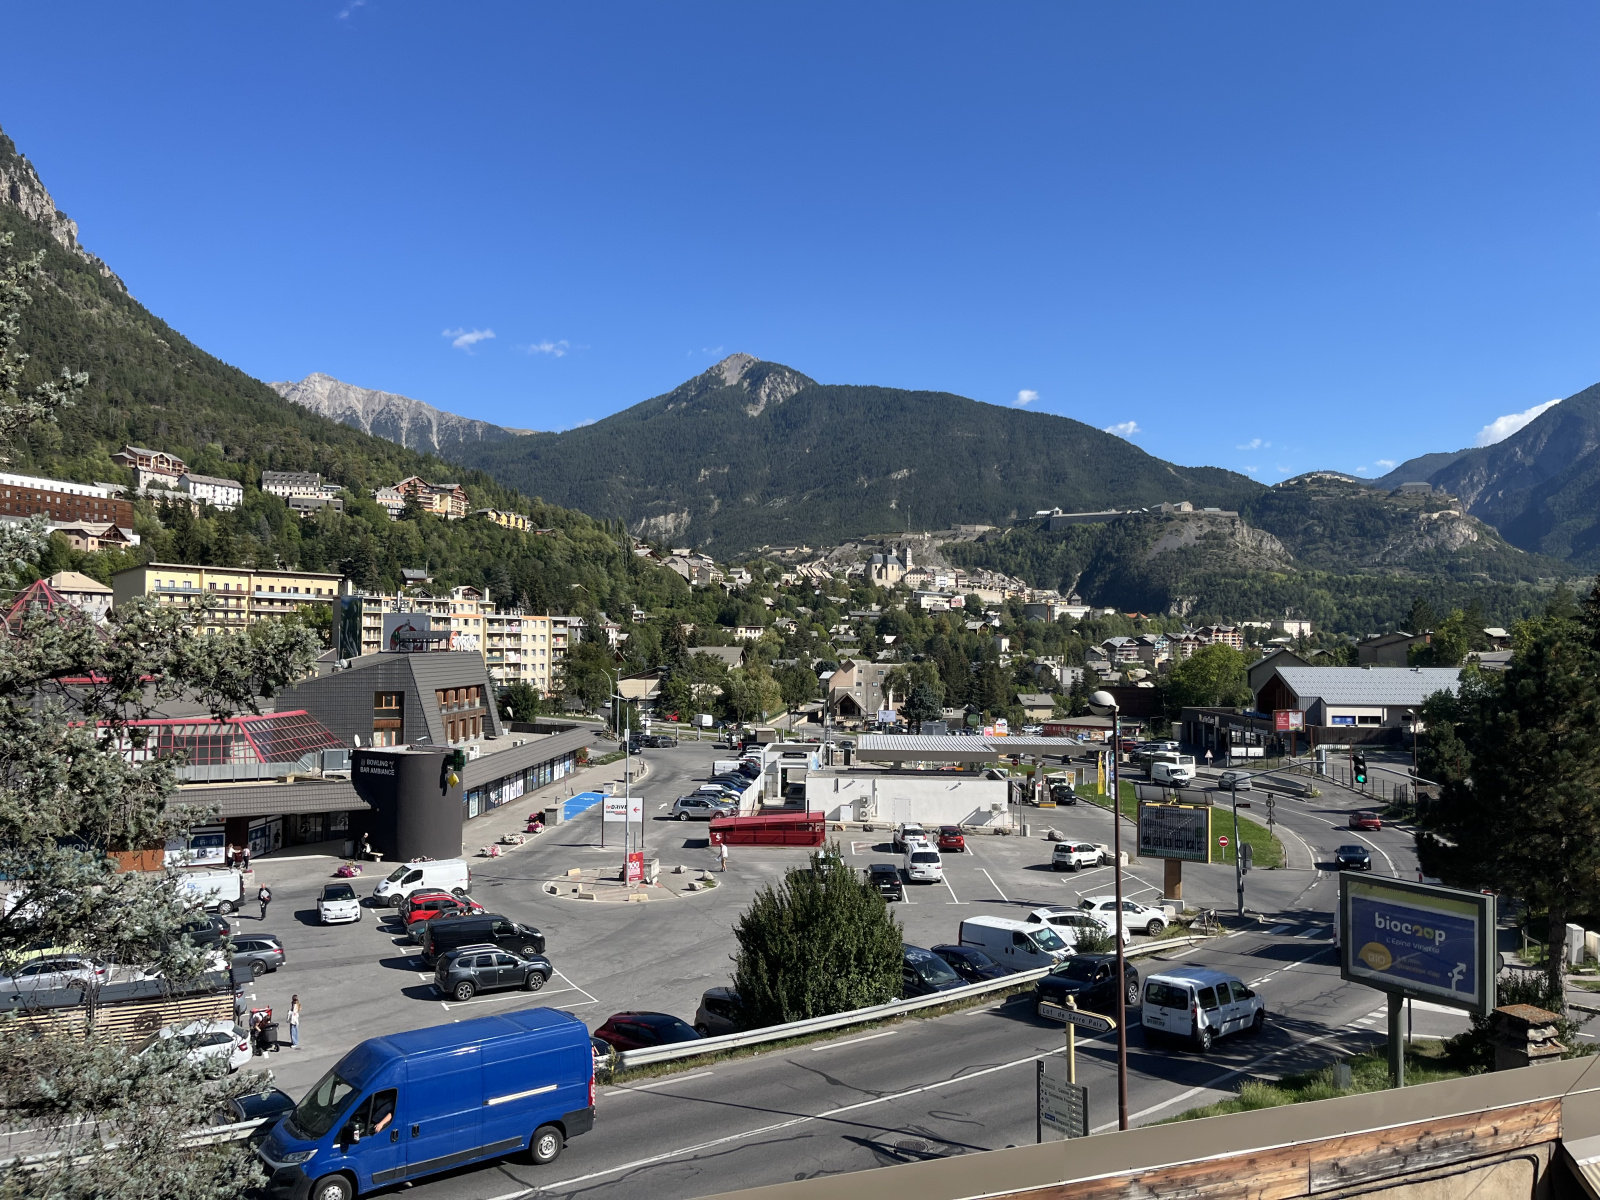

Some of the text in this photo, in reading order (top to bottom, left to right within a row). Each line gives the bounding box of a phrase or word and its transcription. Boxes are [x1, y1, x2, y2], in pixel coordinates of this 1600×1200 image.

[366, 758, 389, 766] BOWLING
[370, 768, 395, 776] AMBIANCE
[1375, 911, 1446, 946] biocoop
[1368, 952, 1386, 965] BIO
[1042, 1007, 1053, 1016] Lot
[1068, 1013, 1086, 1024] Serre
[1088, 1018, 1103, 1028] Paix
